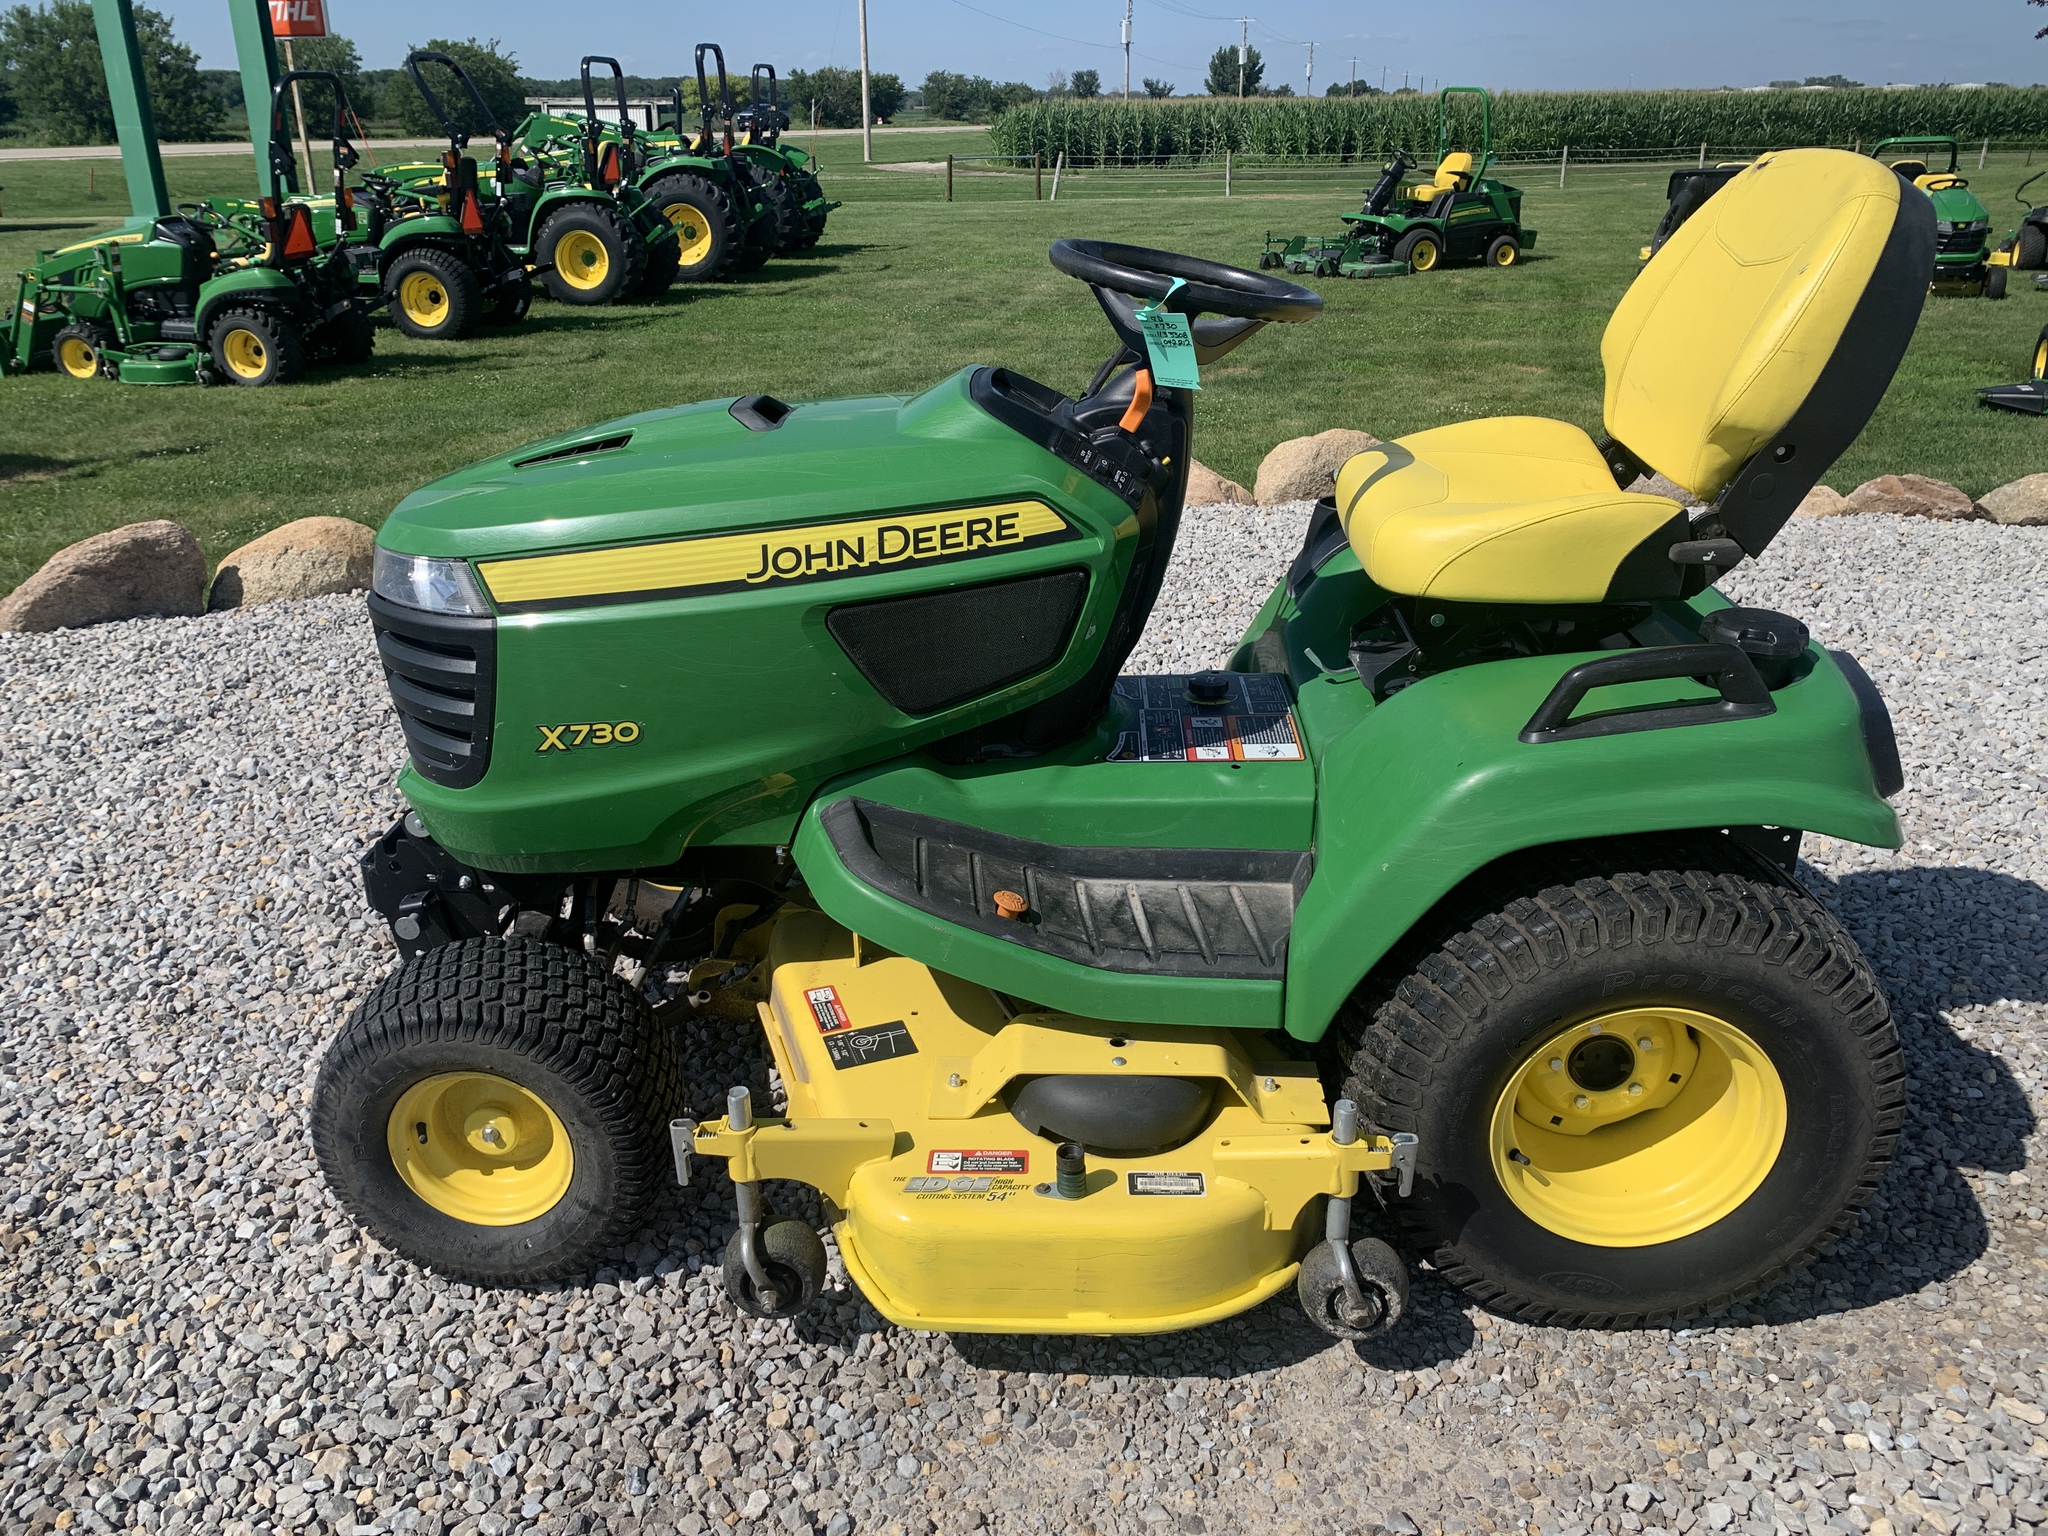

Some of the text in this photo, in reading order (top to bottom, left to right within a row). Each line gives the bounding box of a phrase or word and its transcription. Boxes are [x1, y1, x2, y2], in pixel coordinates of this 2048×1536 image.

[268, 1, 316, 21] TIHL
[746, 512, 1020, 580] JOHN DEERE
[535, 721, 640, 752] X730
[903, 1176, 995, 1192] EDGE
[986, 1192, 1016, 1202] 54"
